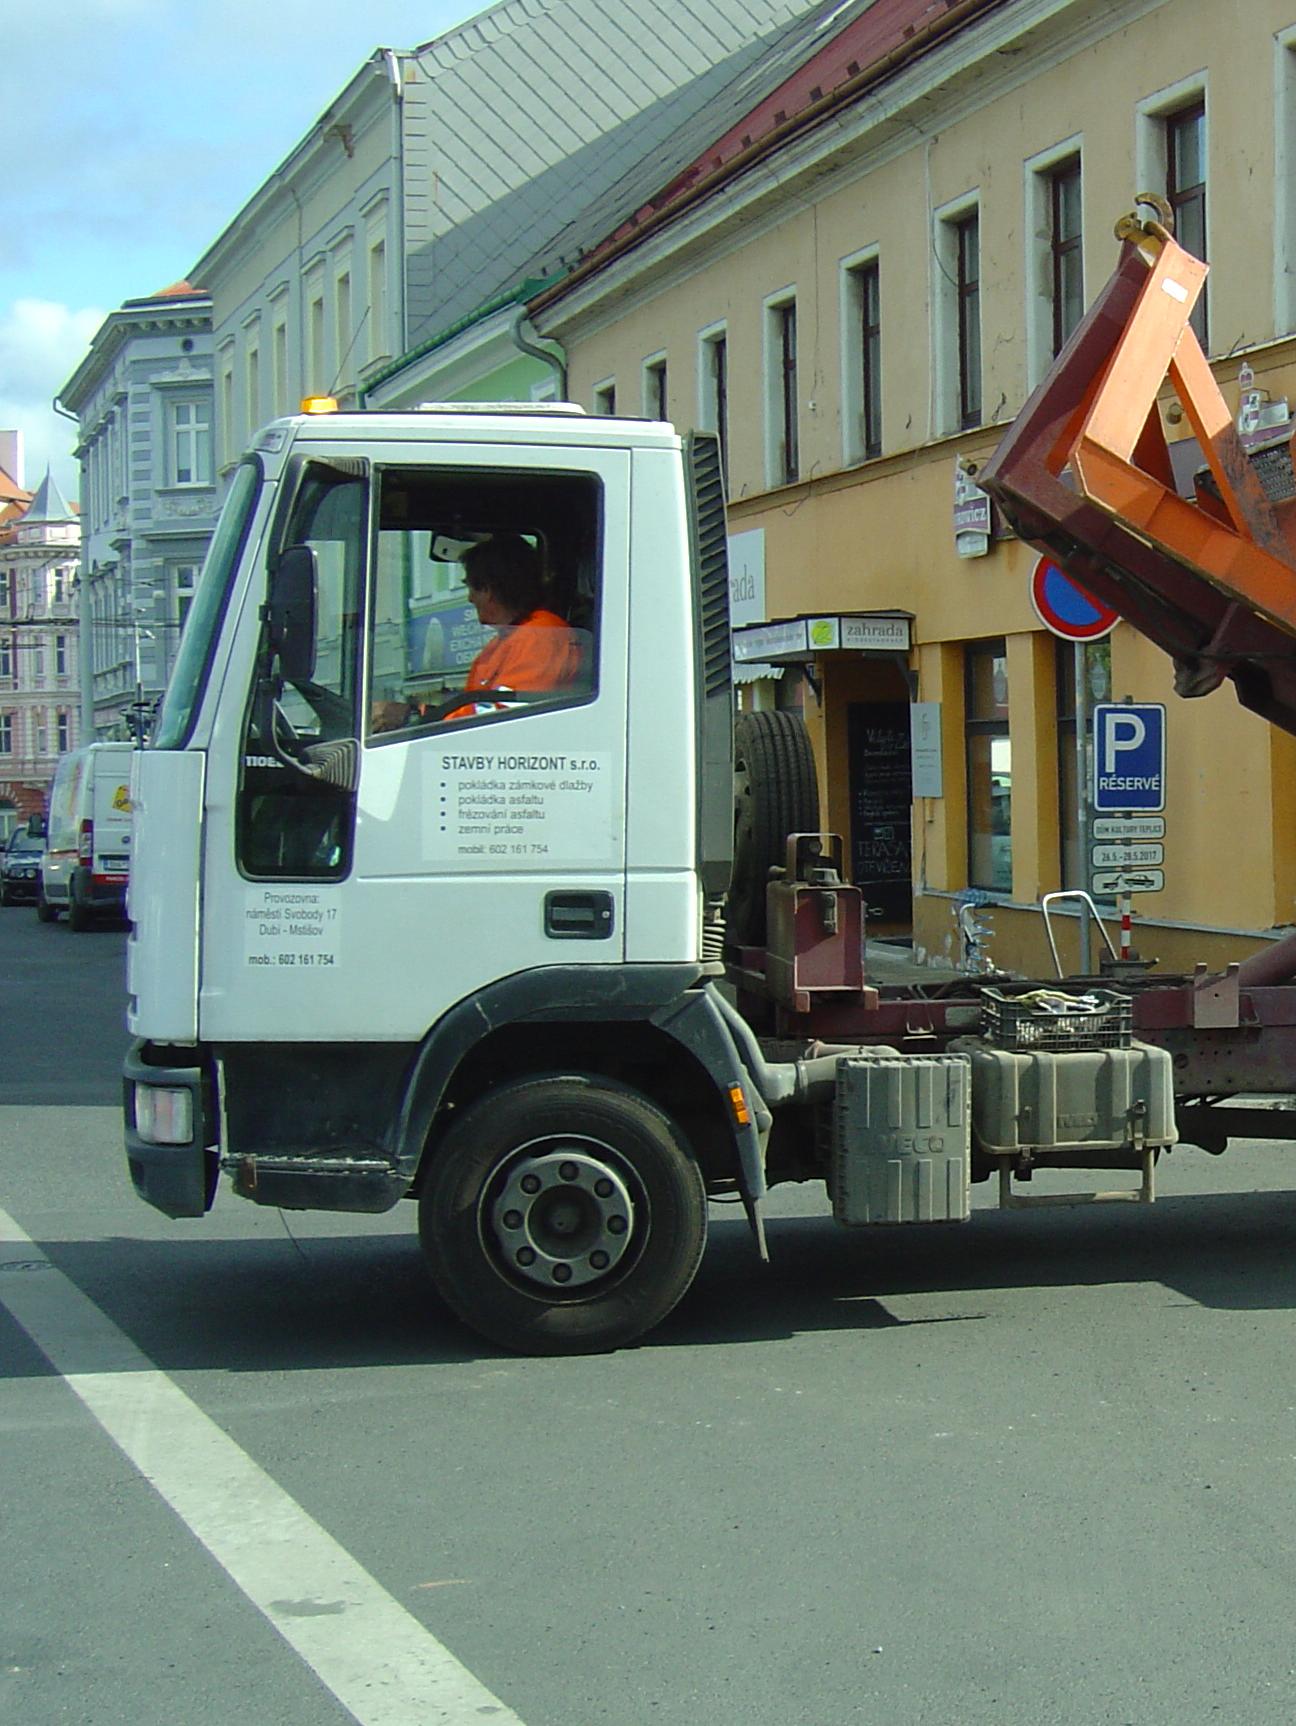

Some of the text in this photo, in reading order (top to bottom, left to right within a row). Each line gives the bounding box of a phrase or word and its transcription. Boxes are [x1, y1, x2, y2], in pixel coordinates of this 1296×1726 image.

[847, 622, 903, 637] zahrada
[1104, 713, 1146, 773] P
[442, 756, 601, 771] STAVBY HORIZONT s.r.o.
[458, 779, 594, 792] pokládka zámkové dlažby
[1099, 774, 1160, 790] RÉSERVÉ
[458, 795, 544, 806] pokládka asfaltu
[458, 809, 545, 819] frézování asfaltu
[458, 824, 524, 835] zemní práce
[458, 845, 549, 854] mobil: 602 161 754
[264, 892, 320, 904] Provozovna:
[284, 908, 323, 922] Svobody
[326, 909, 337, 919] 17
[289, 923, 324, 936] Mstišov
[278, 954, 295, 965] 602
[298, 954, 315, 965] 161
[317, 954, 334, 965] 754
